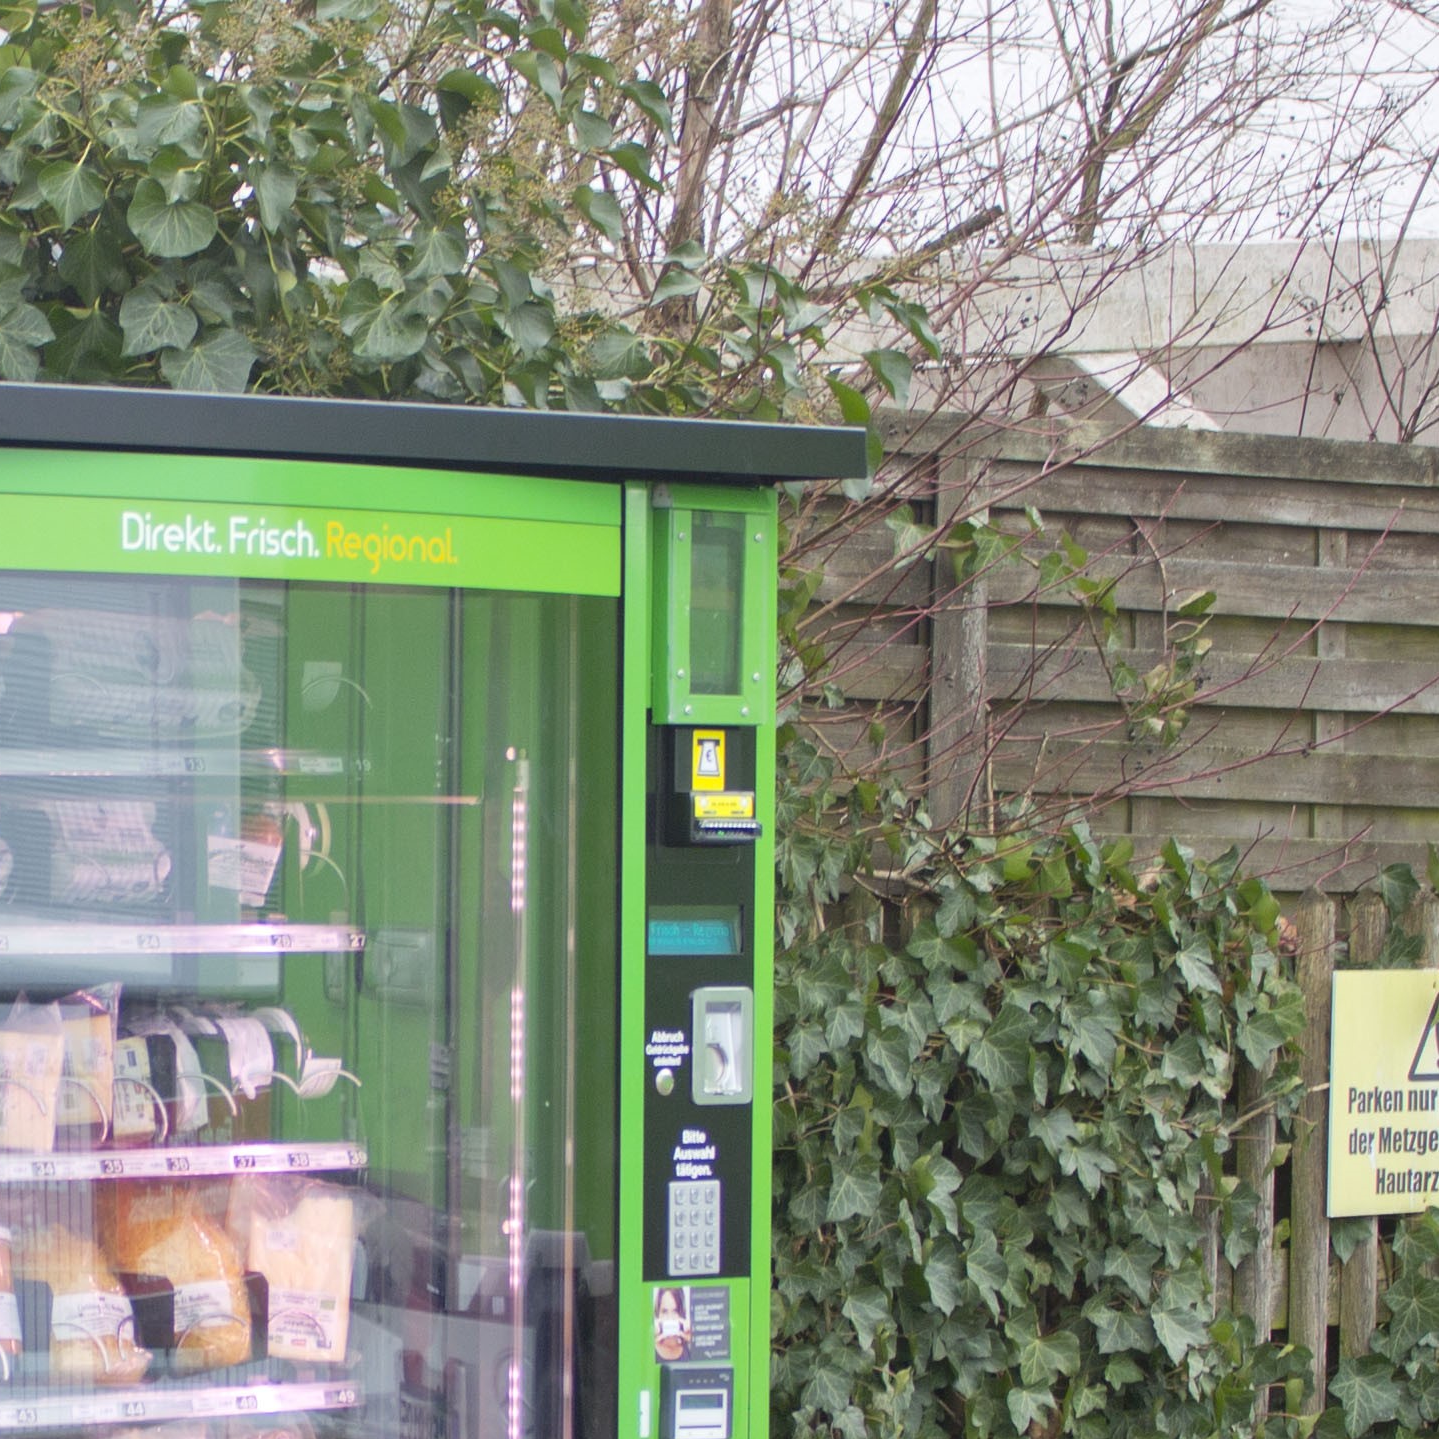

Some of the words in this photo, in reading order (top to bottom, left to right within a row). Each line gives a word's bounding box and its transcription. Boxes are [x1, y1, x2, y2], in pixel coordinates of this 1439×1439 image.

[121, 511, 222, 553] Direkt.
[229, 516, 320, 558] Frisch.
[326, 520, 458, 574] Regional.
[349, 934, 366, 948] 27
[1348, 1086, 1403, 1114] Parken
[1407, 1089, 1438, 1112] nur
[682, 1129, 707, 1144] Bitte
[1348, 1128, 1375, 1155] der
[350, 1151, 368, 1165] 39
[673, 1145, 716, 1160] Auswahl
[35, 1161, 54, 1176] 34
[104, 1159, 122, 1173] 35
[237, 1155, 254, 1168] 37
[675, 1162, 713, 1179] tätigen.
[337, 1390, 355, 1404] 49
[17, 1408, 37, 1423] 43
[125, 1402, 144, 1417] 44
